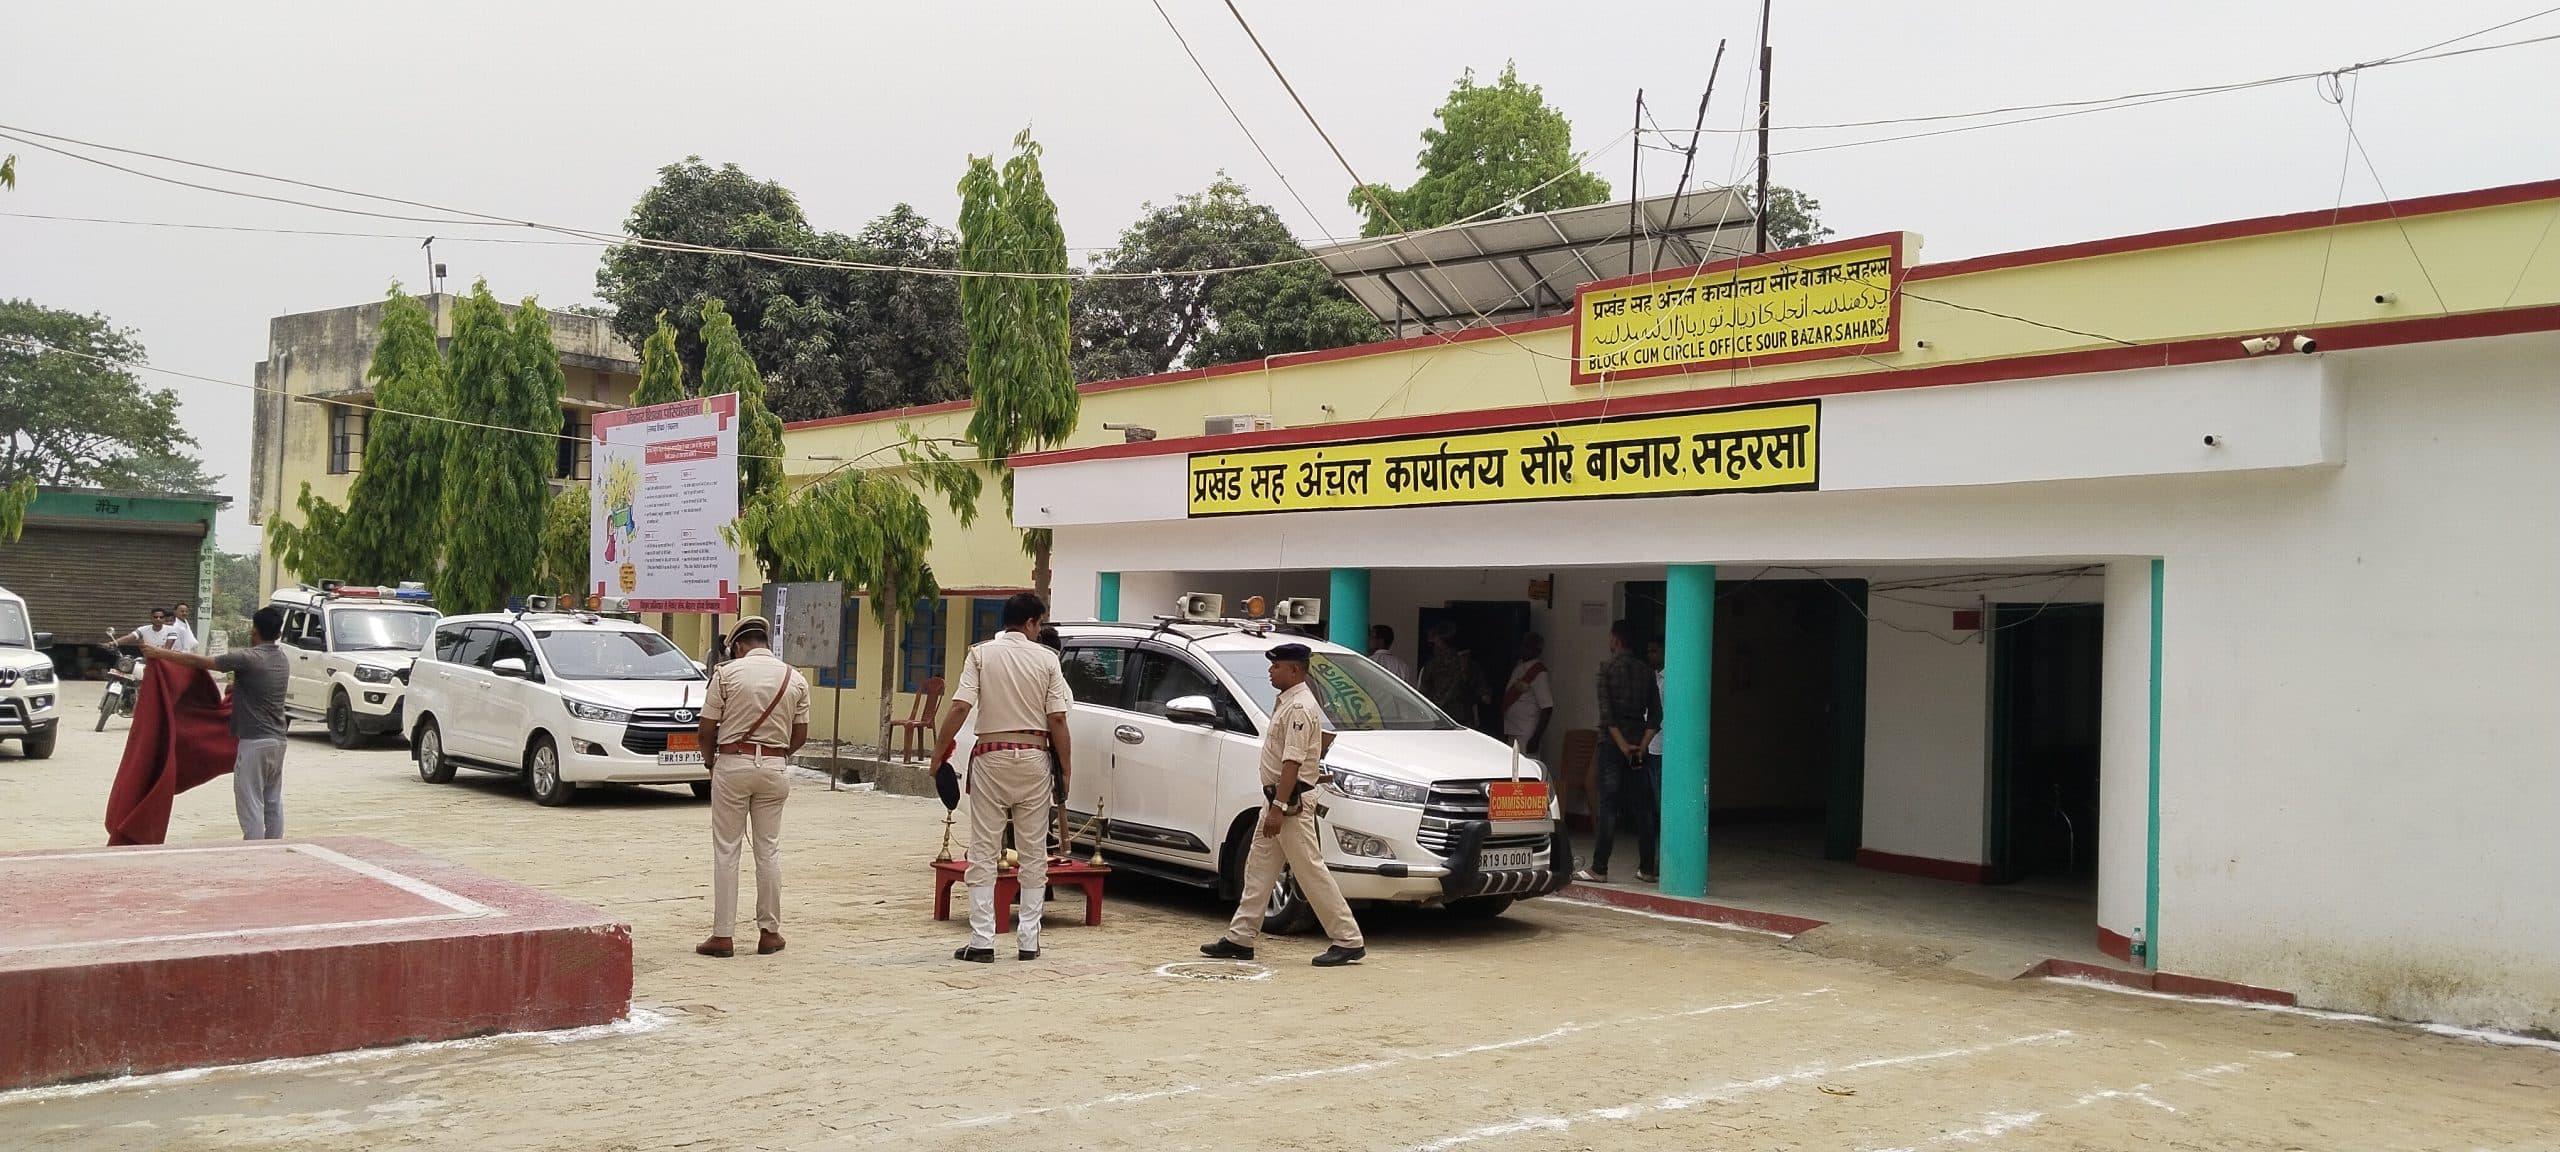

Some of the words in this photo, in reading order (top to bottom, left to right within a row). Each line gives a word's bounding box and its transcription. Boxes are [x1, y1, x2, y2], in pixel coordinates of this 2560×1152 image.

[1593, 292, 1627, 320] प्रखंड
[1630, 294, 1653, 316] सह
[1658, 284, 1697, 310] अंचल
[1846, 256, 1891, 283] सहरसा
[1589, 350, 1629, 370] BLOCK
[1633, 347, 1660, 364] CUM
[1663, 341, 1705, 361] CIRCLE
[1709, 335, 1753, 356] OFFICE
[1755, 331, 1787, 351] SOUR
[1193, 458, 1244, 503] प्रखंड
[1250, 463, 1288, 505] सह
[1296, 451, 1372, 497] अंचल
[1385, 441, 1509, 493] कार्यालय
[1520, 431, 1575, 485] सौर
[1692, 424, 1811, 481] सहरसा
[1492, 795, 1548, 810] COMMISSIONER
